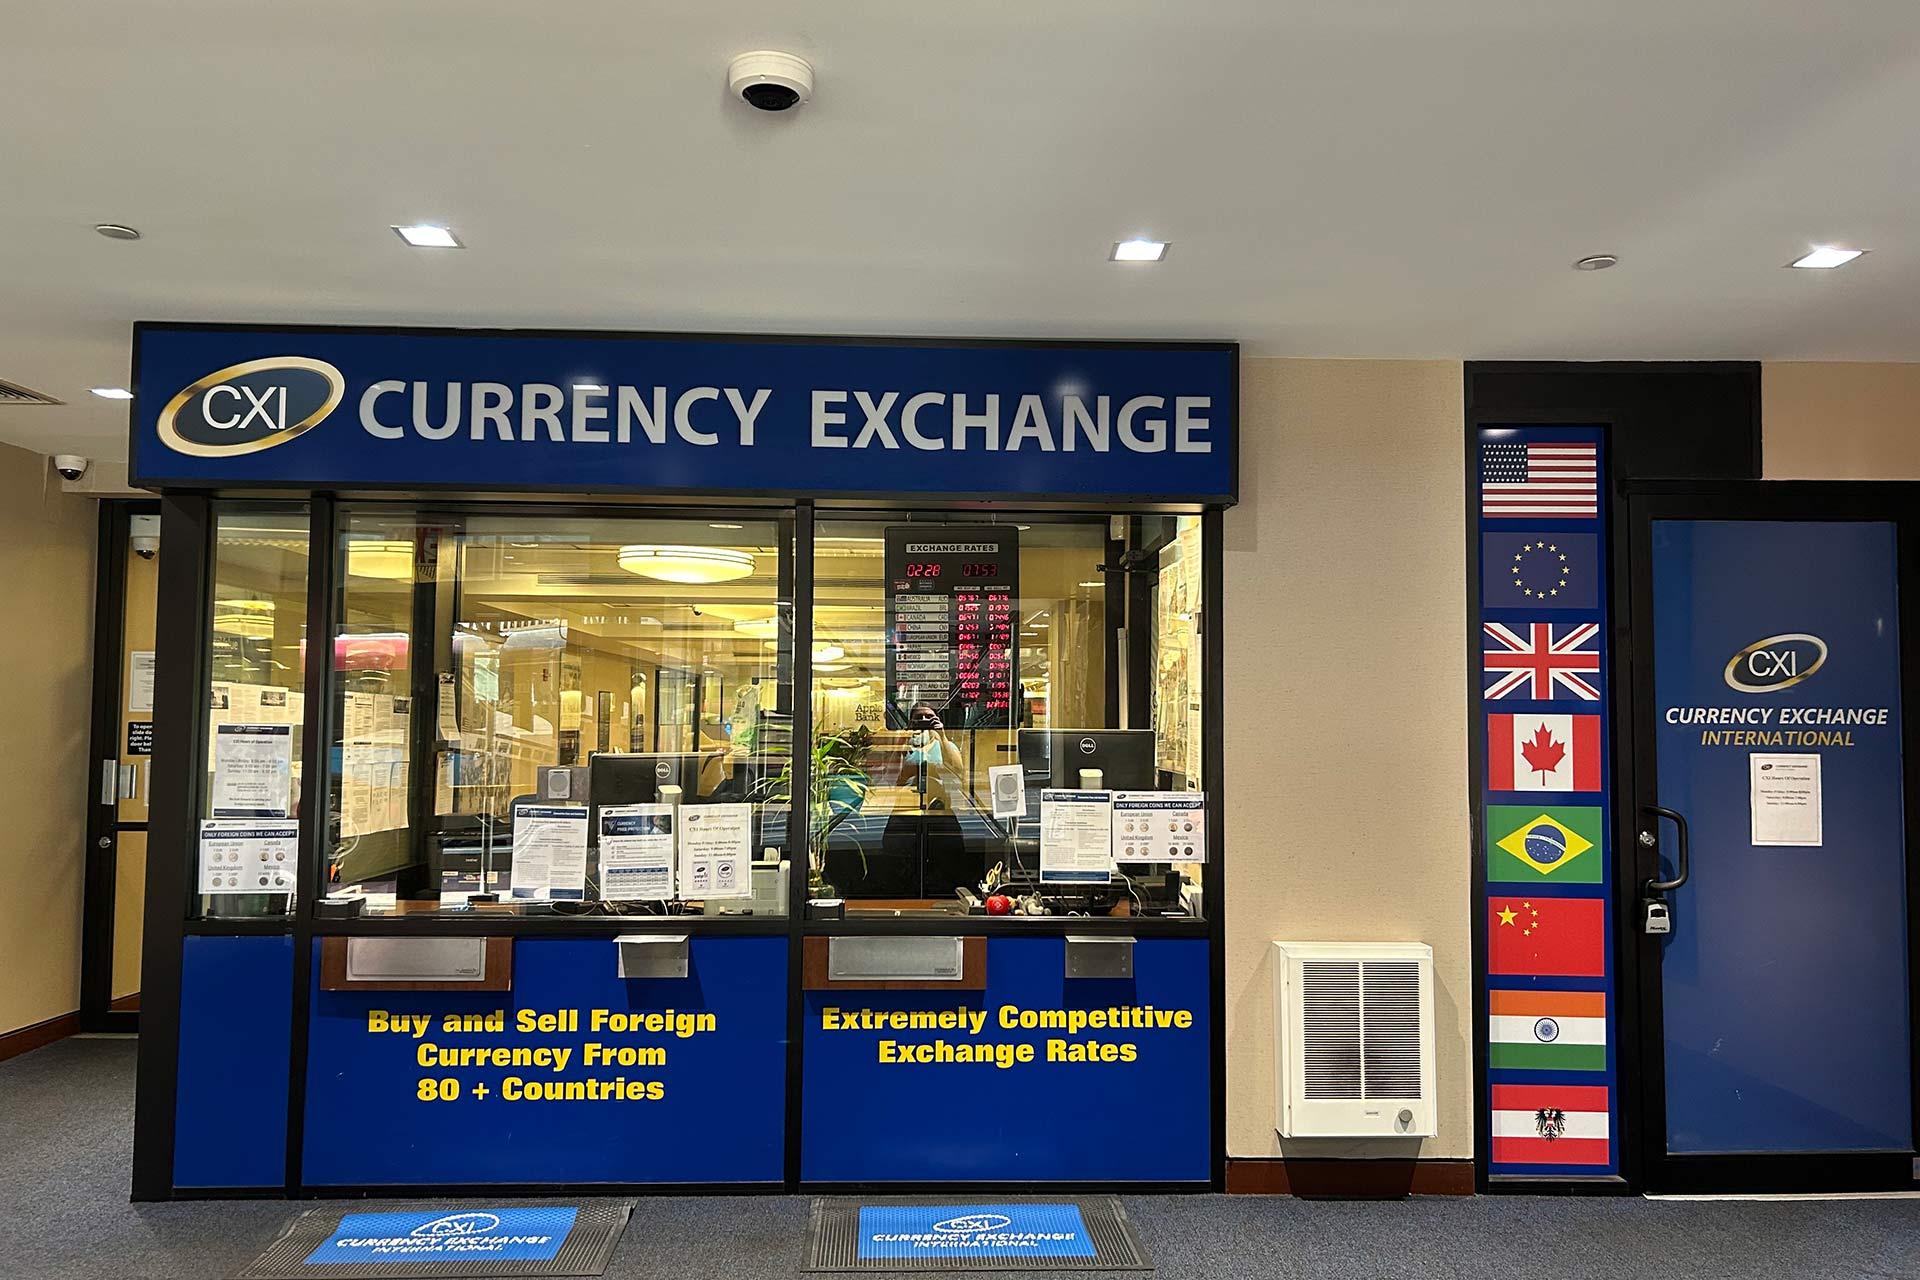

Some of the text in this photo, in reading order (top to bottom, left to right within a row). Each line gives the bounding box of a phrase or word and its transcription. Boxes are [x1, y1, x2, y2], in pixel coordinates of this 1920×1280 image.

[202, 385, 287, 430] CXI
[358, 379, 1213, 453] CURRENCY EXCHANGE
[910, 544, 995, 552] EXCHANGE RATES
[1748, 651, 1797, 677] CXI
[855, 703, 883, 714] Apple
[855, 713, 881, 722] Bank
[1664, 706, 1889, 726] CURRENCY EXCHANGE
[1701, 729, 1856, 746] INTERNATIONAL
[368, 1008, 717, 1038] Buy and Sell Foreign
[822, 1005, 1193, 1035] Extremely Competitive
[416, 1043, 667, 1072] Currency From
[878, 1039, 1138, 1069] Exchange Rates
[416, 1077, 665, 1101] 80 + Countries
[336, 1234, 552, 1248] CURRENCY EXCHANGE
[872, 1232, 1075, 1242] CURRENCY EXCHANGE
[913, 1240, 1039, 1248] INTERNATIONAL
[371, 1243, 504, 1254] INTERNATIONAL
